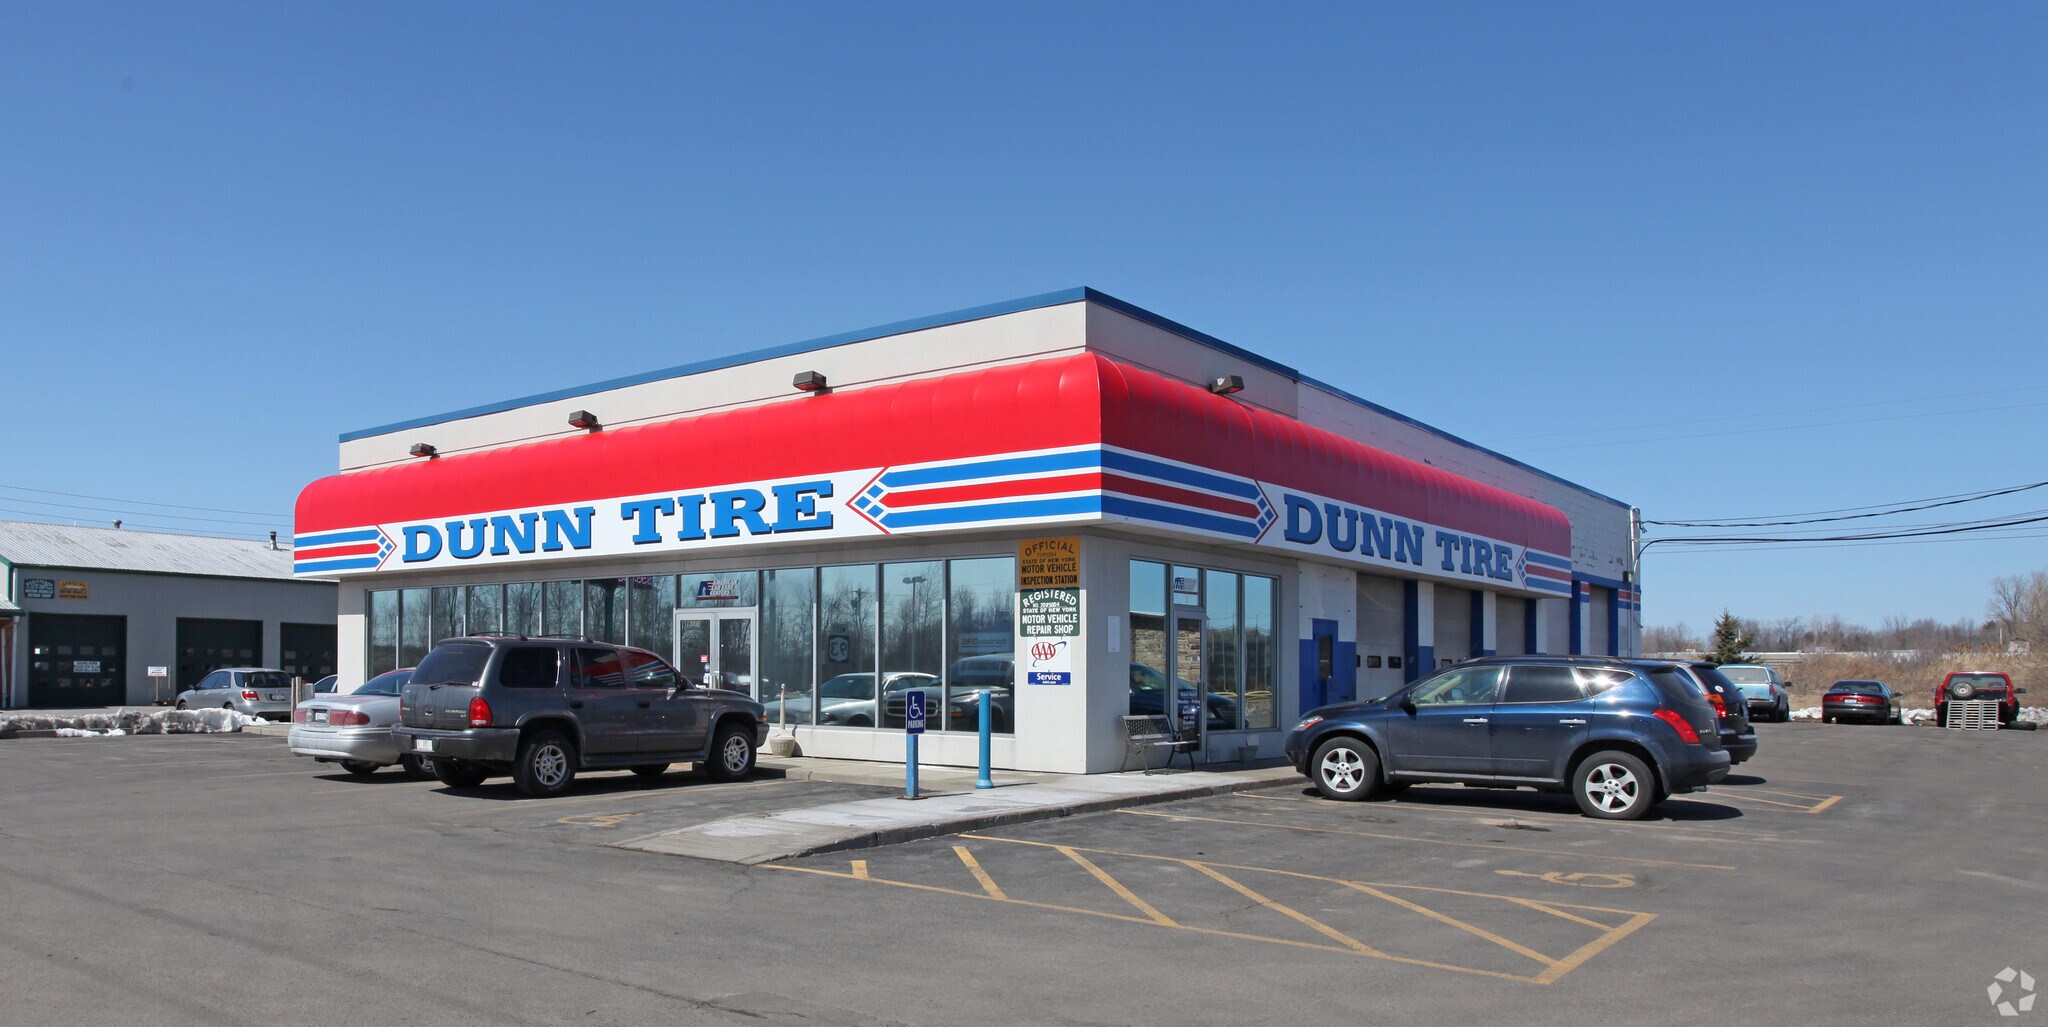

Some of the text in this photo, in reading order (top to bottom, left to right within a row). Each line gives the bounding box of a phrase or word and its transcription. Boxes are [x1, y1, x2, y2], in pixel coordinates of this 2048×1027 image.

[402, 479, 833, 563] DUNN TIRE
[1283, 493, 1513, 582] DUNN TIRE
[1024, 540, 1075, 556] OFFICIAL
[1021, 563, 1077, 574] MOTOR VEHICLE
[1021, 574, 1078, 585] INSPECTION STATION
[1022, 589, 1077, 608] REGISTERED
[1022, 613, 1078, 624] MOTOR VEHICLE
[1026, 624, 1074, 634] REPAIR SHOP
[961, 638, 1007, 646] BFGoodrich
[1032, 642, 1056, 660] AAA
[1036, 672, 1062, 681] Service
[907, 719, 924, 729] PARKING
